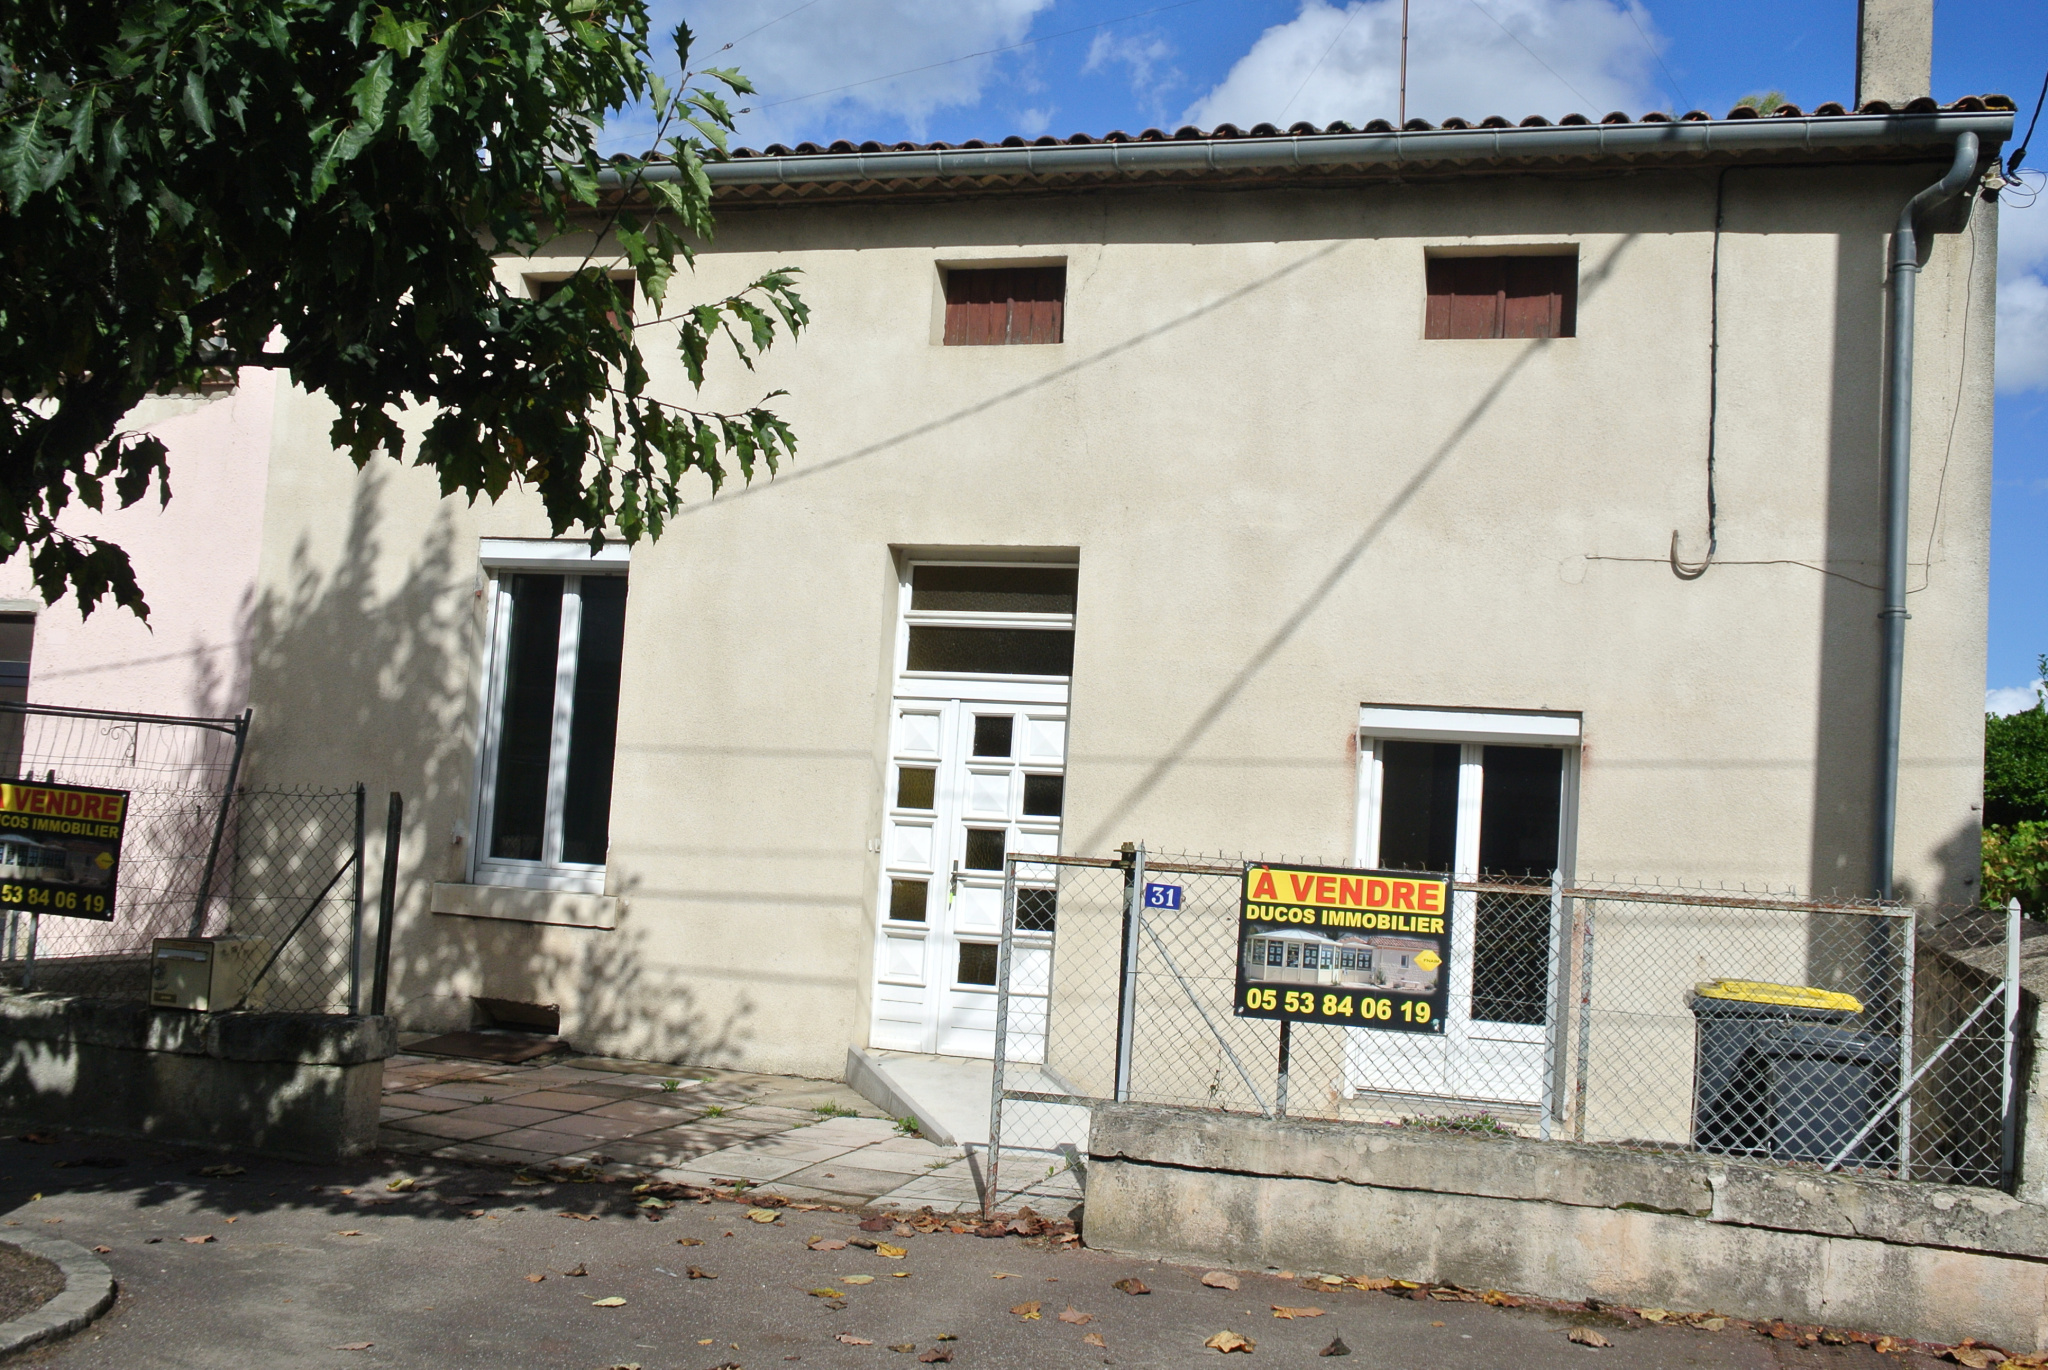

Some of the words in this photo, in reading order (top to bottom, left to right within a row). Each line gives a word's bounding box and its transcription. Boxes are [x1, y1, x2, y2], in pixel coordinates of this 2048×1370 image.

[14, 786, 120, 822] VENDRE
[0, 814, 29, 829] COS
[32, 818, 119, 839] IMMOBILIER
[1, 884, 23, 903] 53
[27, 888, 50, 906] 84
[55, 891, 77, 909] 06
[83, 894, 105, 912] 19
[1151, 886, 1174, 907] 31
[1290, 874, 1439, 912] VENDRE
[1246, 904, 1316, 925] DUCOS
[1321, 909, 1445, 934] IMMOBILIER
[1246, 988, 1277, 1011] 05
[1284, 991, 1315, 1014] 53
[1322, 995, 1353, 1017] 84
[1361, 998, 1392, 1020] 06
[1400, 1001, 1431, 1024] 19
